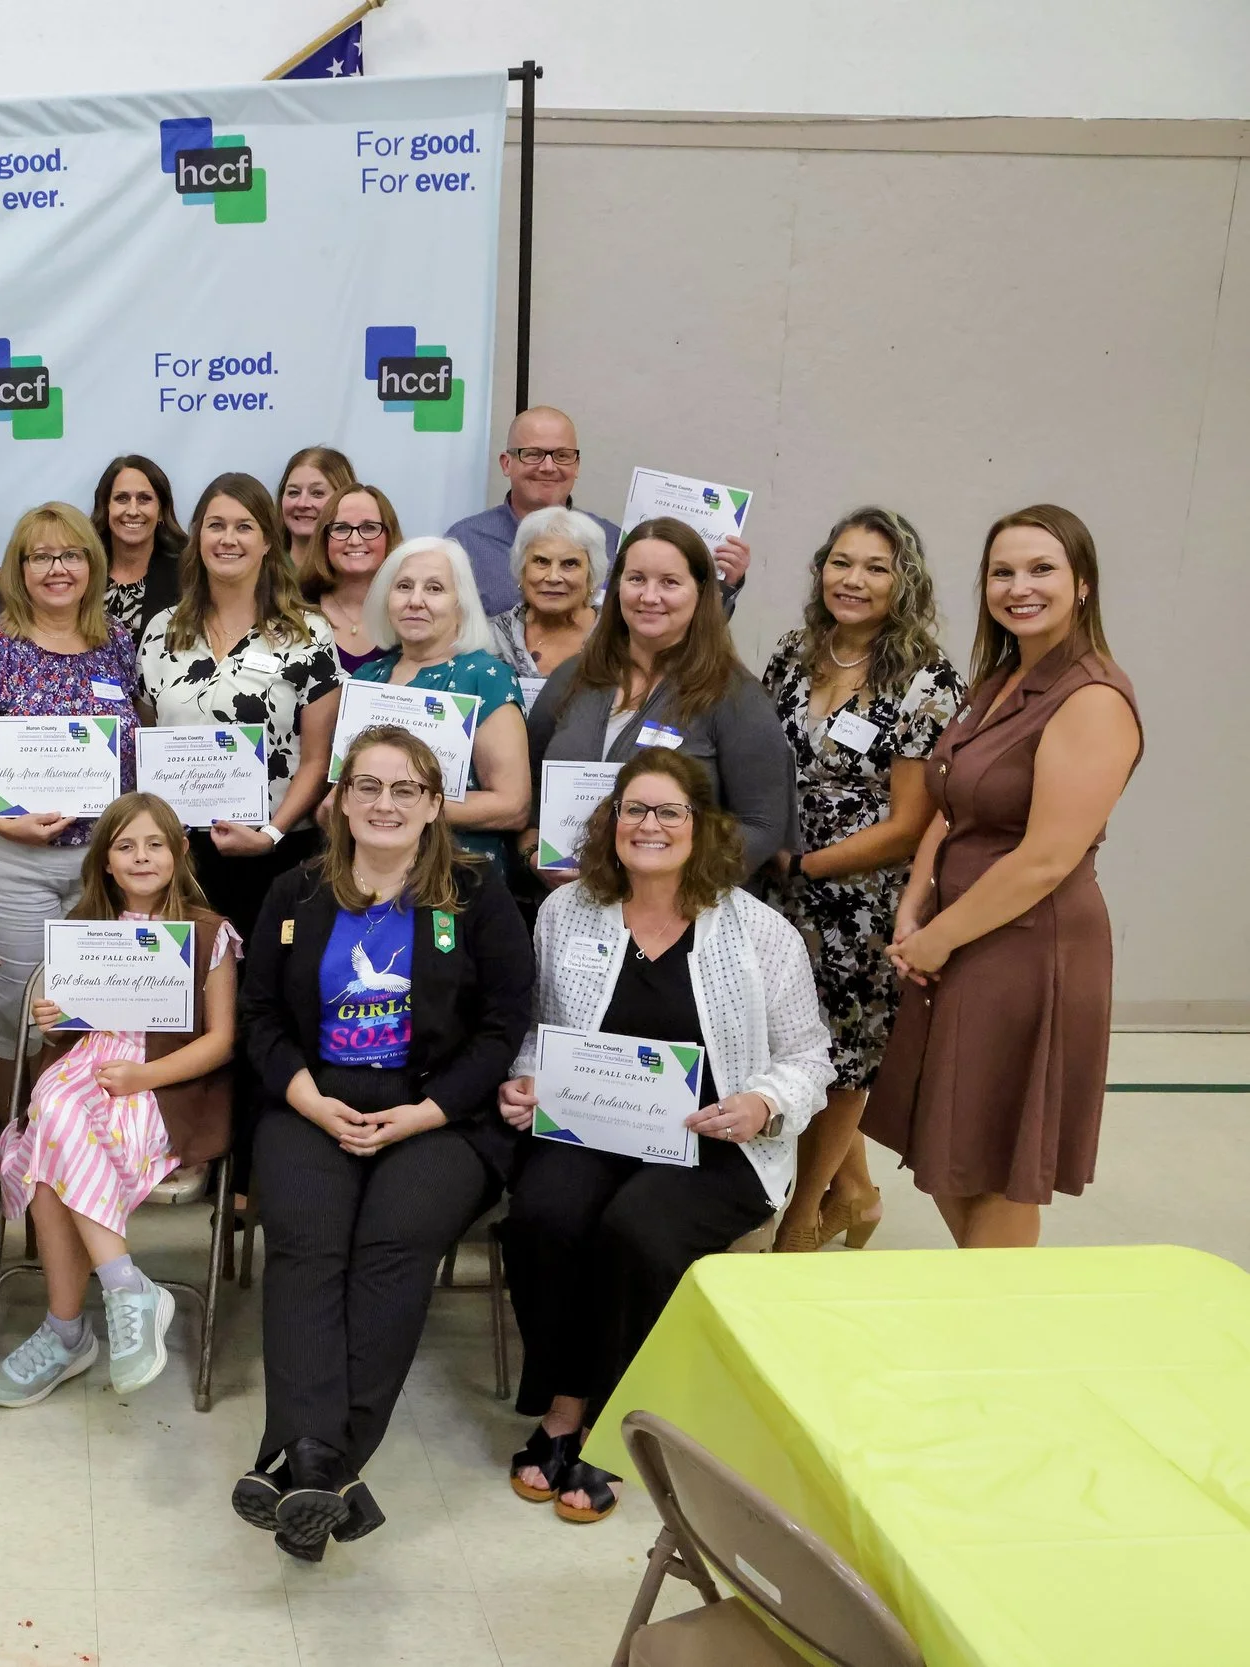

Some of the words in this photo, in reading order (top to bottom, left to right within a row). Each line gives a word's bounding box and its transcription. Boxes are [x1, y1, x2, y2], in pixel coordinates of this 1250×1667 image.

[357, 131, 404, 156] For
[410, 129, 480, 160] good.
[180, 155, 248, 185] hccf
[363, 168, 409, 193] For
[416, 173, 475, 192] ever.
[3, 190, 64, 210] ever.
[155, 353, 202, 377] For
[208, 352, 278, 381] good.
[382, 366, 448, 393] hccf
[160, 388, 207, 412] For
[213, 393, 273, 411] ever.
[370, 714, 390, 722] 2026
[391, 717, 410, 725] FALL
[412, 720, 439, 729] GRANT
[17, 768, 40, 780] Area
[42, 766, 84, 779] Historical
[82, 767, 111, 782] Society
[151, 769, 186, 782] Hospital
[185, 768, 227, 783] Hospitality
[230, 766, 252, 778] House
[178, 781, 189, 795] of
[189, 781, 225, 794] Saginaw
[50, 973, 73, 991] Girl
[72, 974, 101, 986] Scouts
[103, 974, 131, 987] Heart
[131, 976, 144, 992] of
[584, 1041, 602, 1050] Huron
[602, 1044, 624, 1053] County
[573, 1065, 596, 1074] 2026
[598, 1069, 622, 1078] FALL
[624, 1073, 658, 1084] GRANT
[555, 1086, 589, 1102] Thumb
[645, 1145, 680, 1157] $2,000
